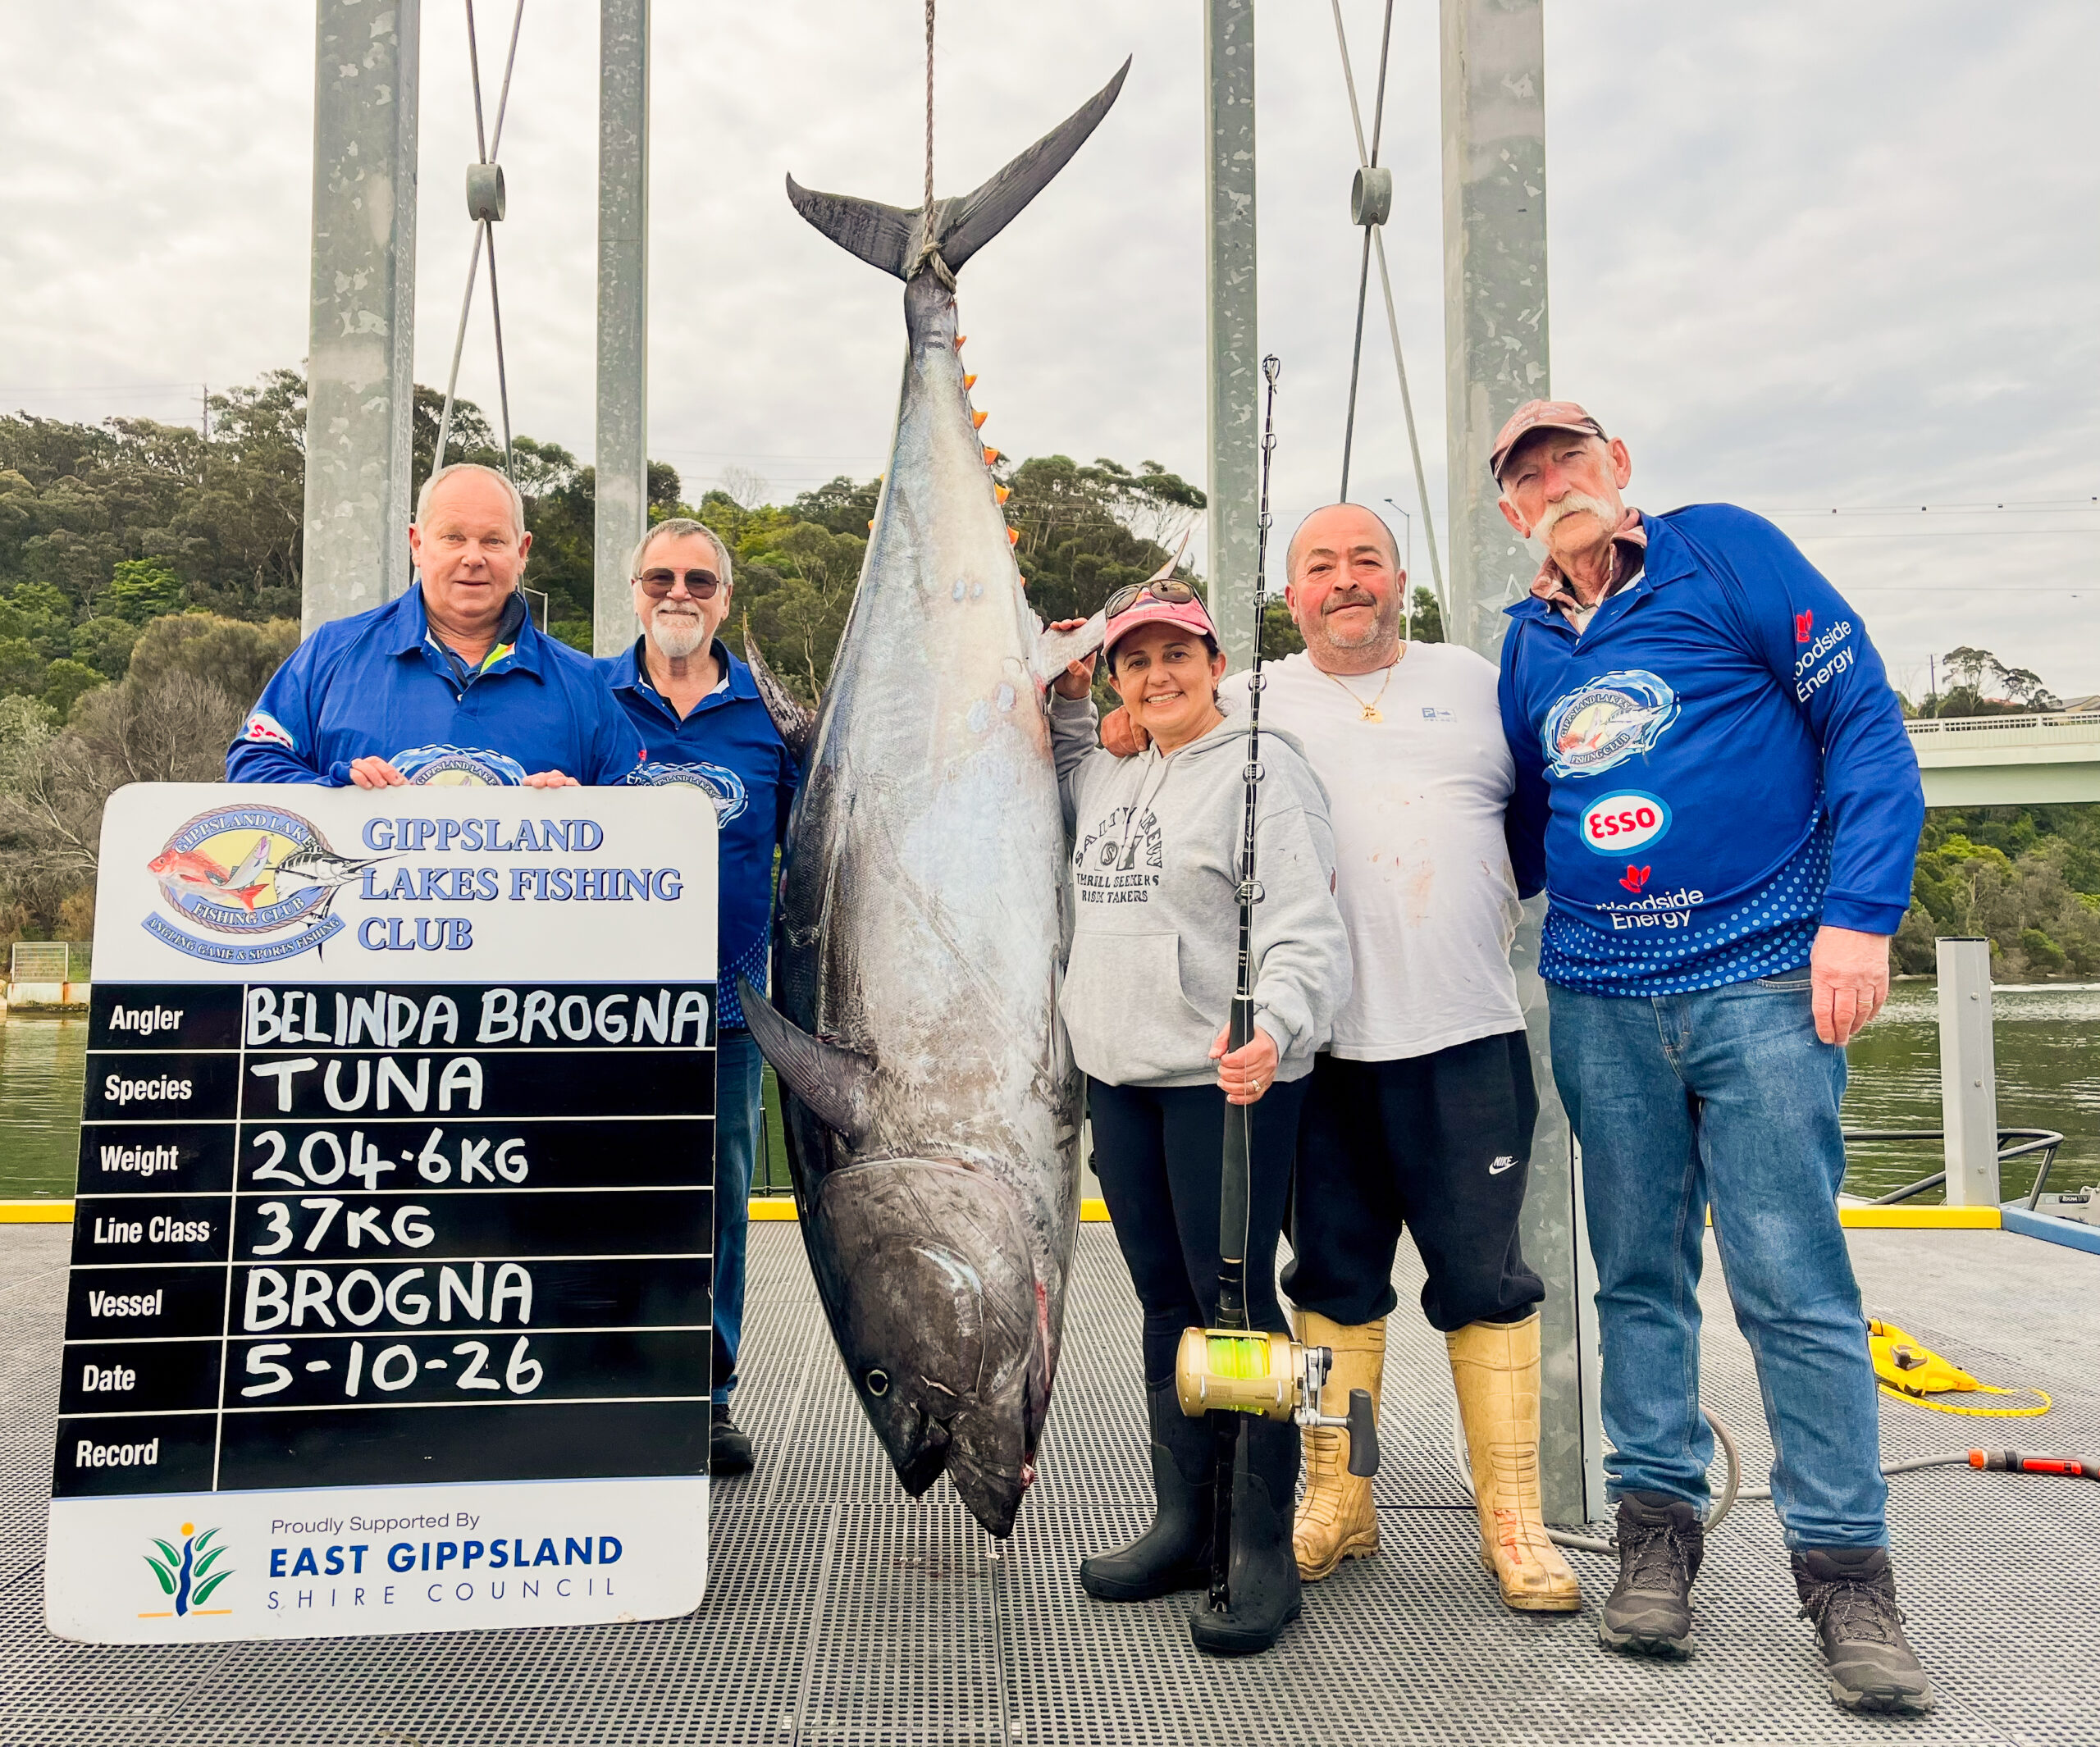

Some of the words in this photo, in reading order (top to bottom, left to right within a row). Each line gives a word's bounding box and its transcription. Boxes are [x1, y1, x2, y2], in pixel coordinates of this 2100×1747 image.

[1794, 621, 1851, 679] oodside
[1796, 645, 1854, 703] Energy
[1560, 696, 1596, 737] GIPPSLAND
[1596, 693, 1633, 710] LAKES
[1570, 748, 1603, 764] FISHING
[1603, 732, 1631, 755] CLUB
[415, 759, 469, 786] GIPPSLAND
[470, 765, 497, 786] LAKE
[174, 813, 267, 855] GIPPSLAND
[270, 816, 324, 855] LAKES
[362, 819, 604, 852] GIPPSLAND
[1139, 807, 1162, 869] REW
[359, 868, 499, 901] LAKES
[509, 868, 684, 901] FISHING
[1076, 873, 1111, 888] THRILL
[1113, 874, 1160, 888] SEEKERS
[1082, 890, 1105, 903] RISK
[1107, 890, 1148, 904] TAKERS
[191, 901, 259, 926] FISHING
[261, 896, 306, 924] CLUB
[1610, 909, 1691, 930] Energy
[147, 917, 196, 951] ANGLING
[198, 943, 234, 960] GAME
[236, 950, 246, 960] &
[249, 941, 294, 960] SPORTS
[295, 915, 341, 949] FISHING
[358, 917, 473, 951] CLUB
[108, 1005, 184, 1036] Angler
[247, 987, 459, 1048] BELINDA
[475, 988, 710, 1047] BROGNA
[104, 1074, 192, 1106] Species
[250, 1056, 484, 1112] TUNA
[100, 1145, 180, 1177] Weight
[1493, 1155, 1513, 1167] NIKE
[94, 1217, 143, 1244] Line
[148, 1216, 210, 1243] Class
[251, 1197, 436, 1256] 37KG
[89, 1289, 163, 1317] Vessel
[244, 1261, 533, 1333] BROGNA
[82, 1365, 136, 1392] Date
[240, 1335, 544, 1398] 5-10-26
[75, 1437, 159, 1467] Record
[271, 1517, 345, 1536] Proudly
[349, 1513, 450, 1535] Supported
[456, 1512, 481, 1531] By
[269, 1544, 369, 1578] EAST
[387, 1535, 623, 1572] GIPPSLAND
[267, 1585, 395, 1610] SHIRE
[427, 1577, 615, 1603] COUNCIL
